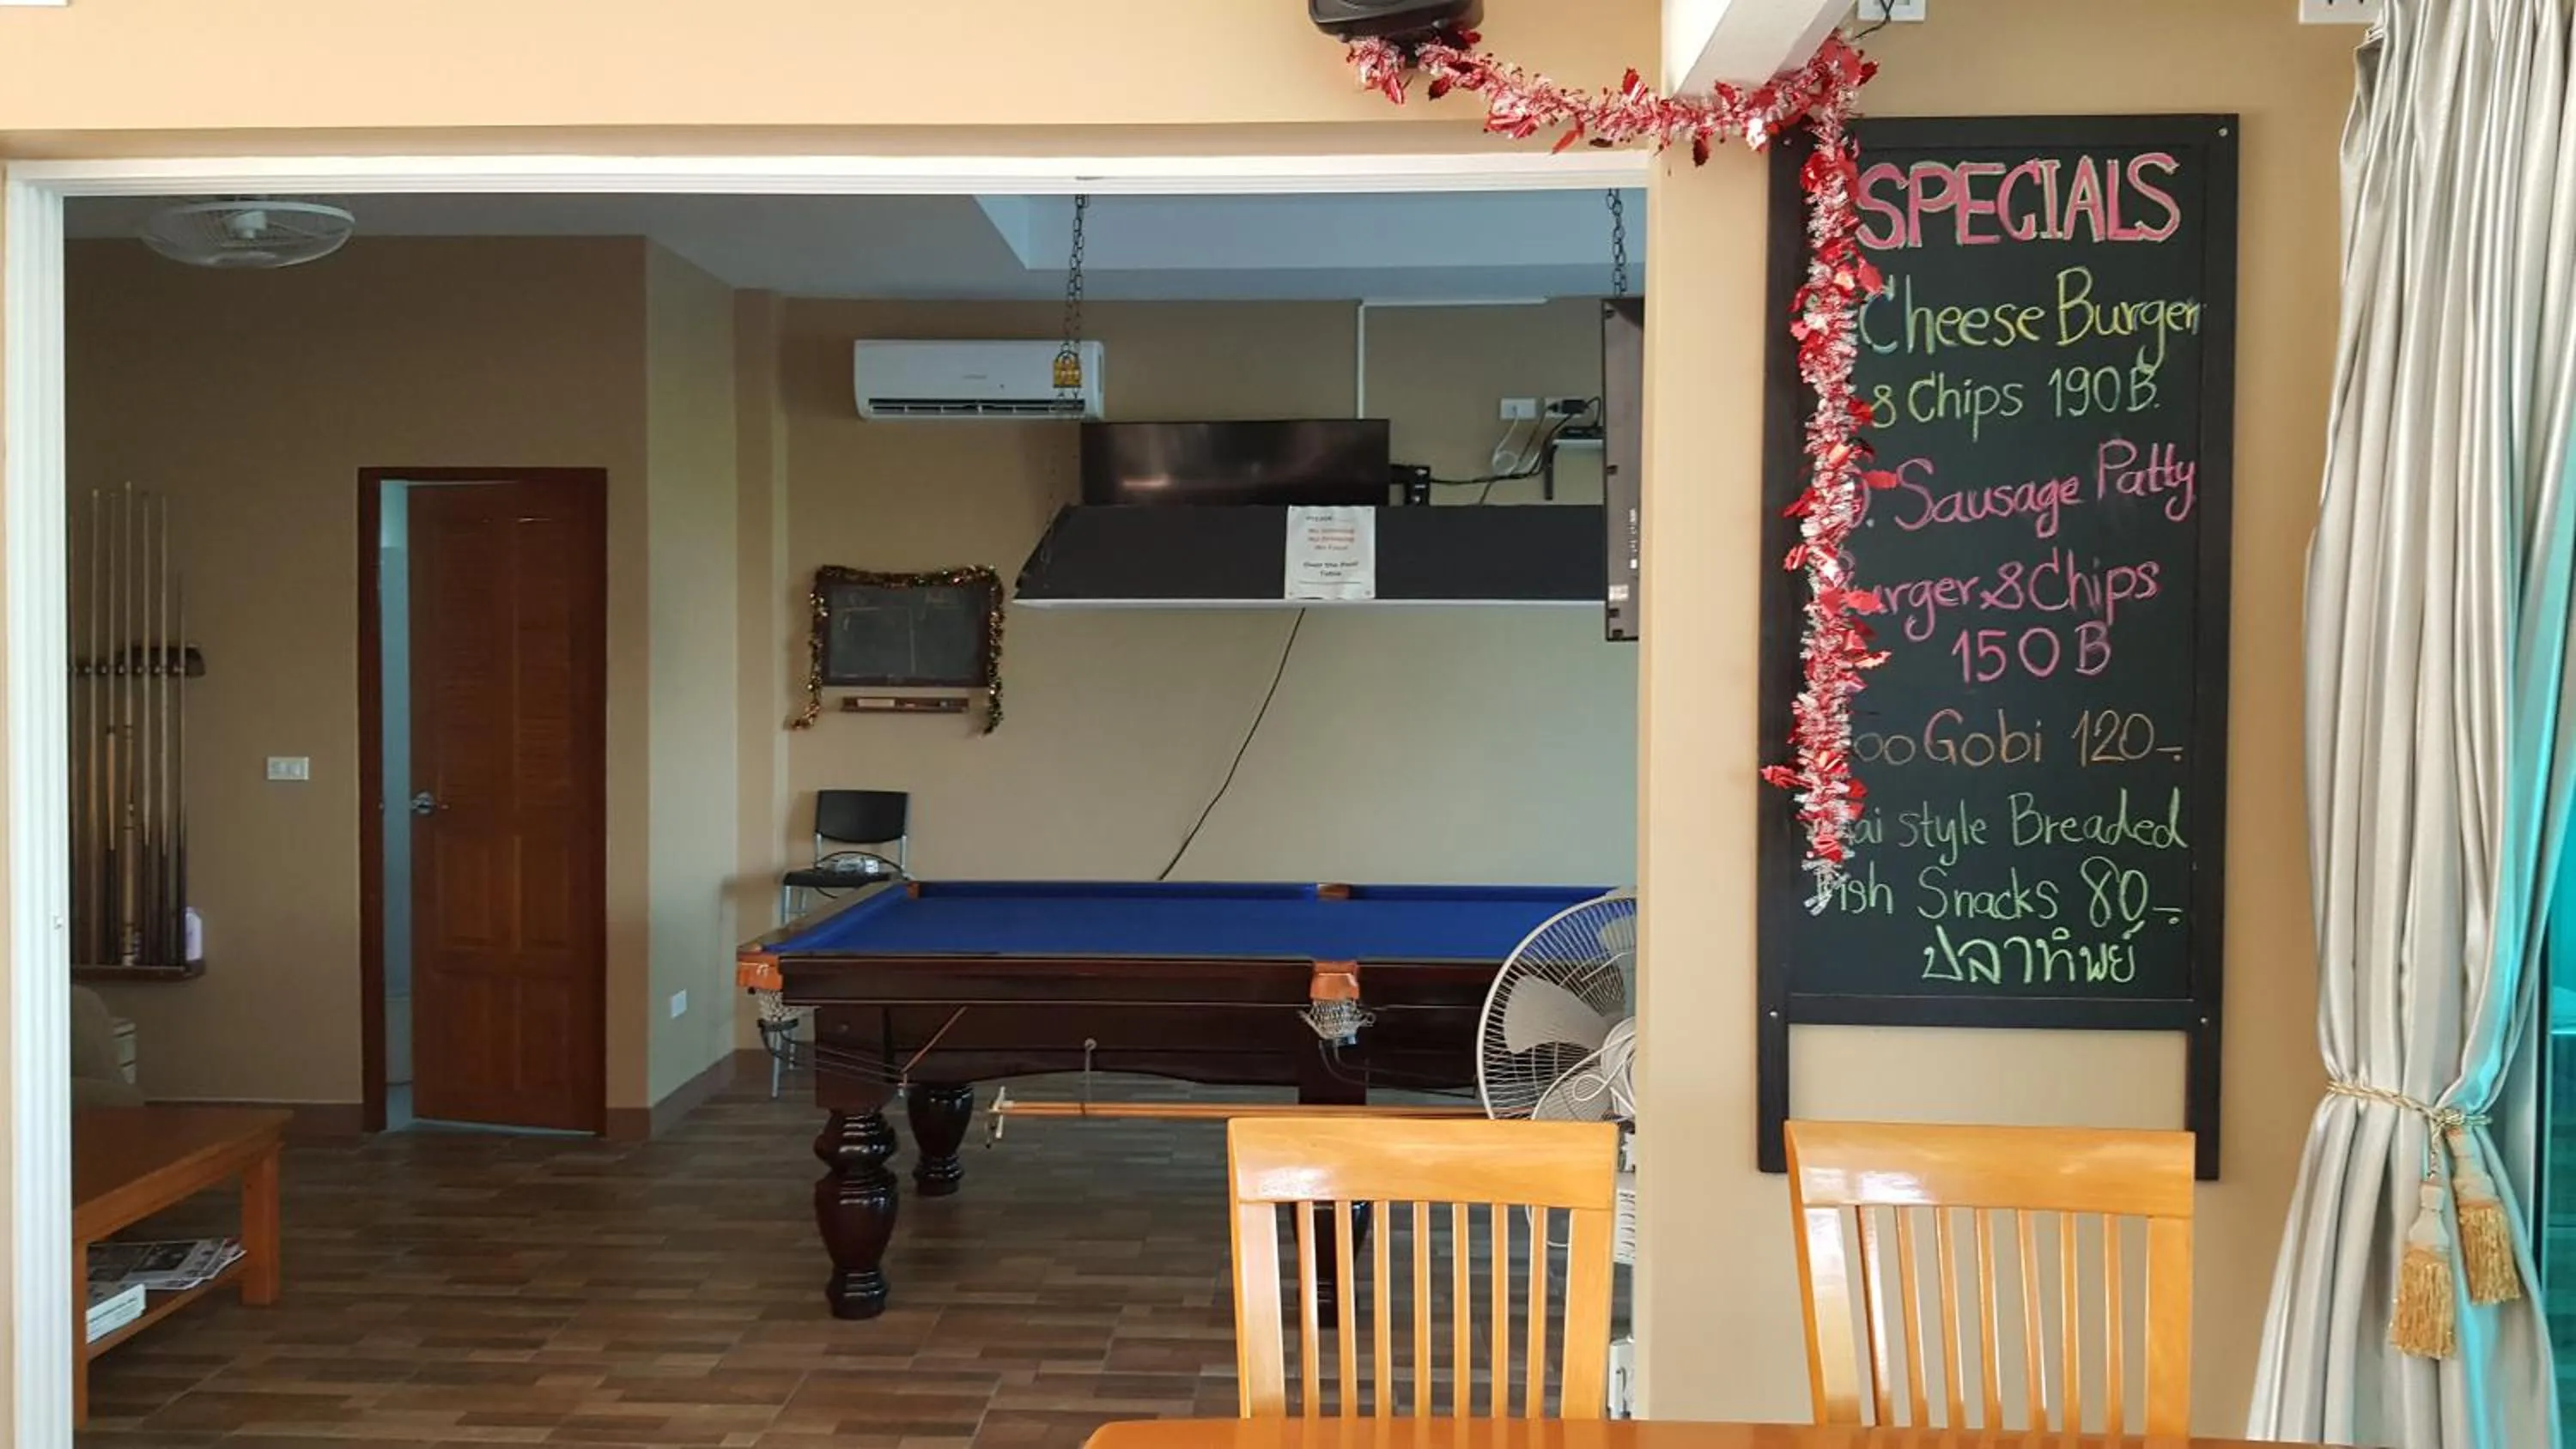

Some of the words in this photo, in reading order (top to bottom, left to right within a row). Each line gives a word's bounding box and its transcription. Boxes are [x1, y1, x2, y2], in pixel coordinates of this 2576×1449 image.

[1856, 151, 2181, 249] SPECIALS
[1859, 275, 2045, 355] Cheese
[2056, 266, 2201, 374] Burger
[1908, 371, 2024, 444] Chips
[1894, 458, 2085, 538] Sausage
[2098, 439, 2196, 522] Patty
[1899, 799, 1988, 866] style
[2008, 785, 2190, 849] Breaded
[1917, 864, 2059, 920] Snacks
